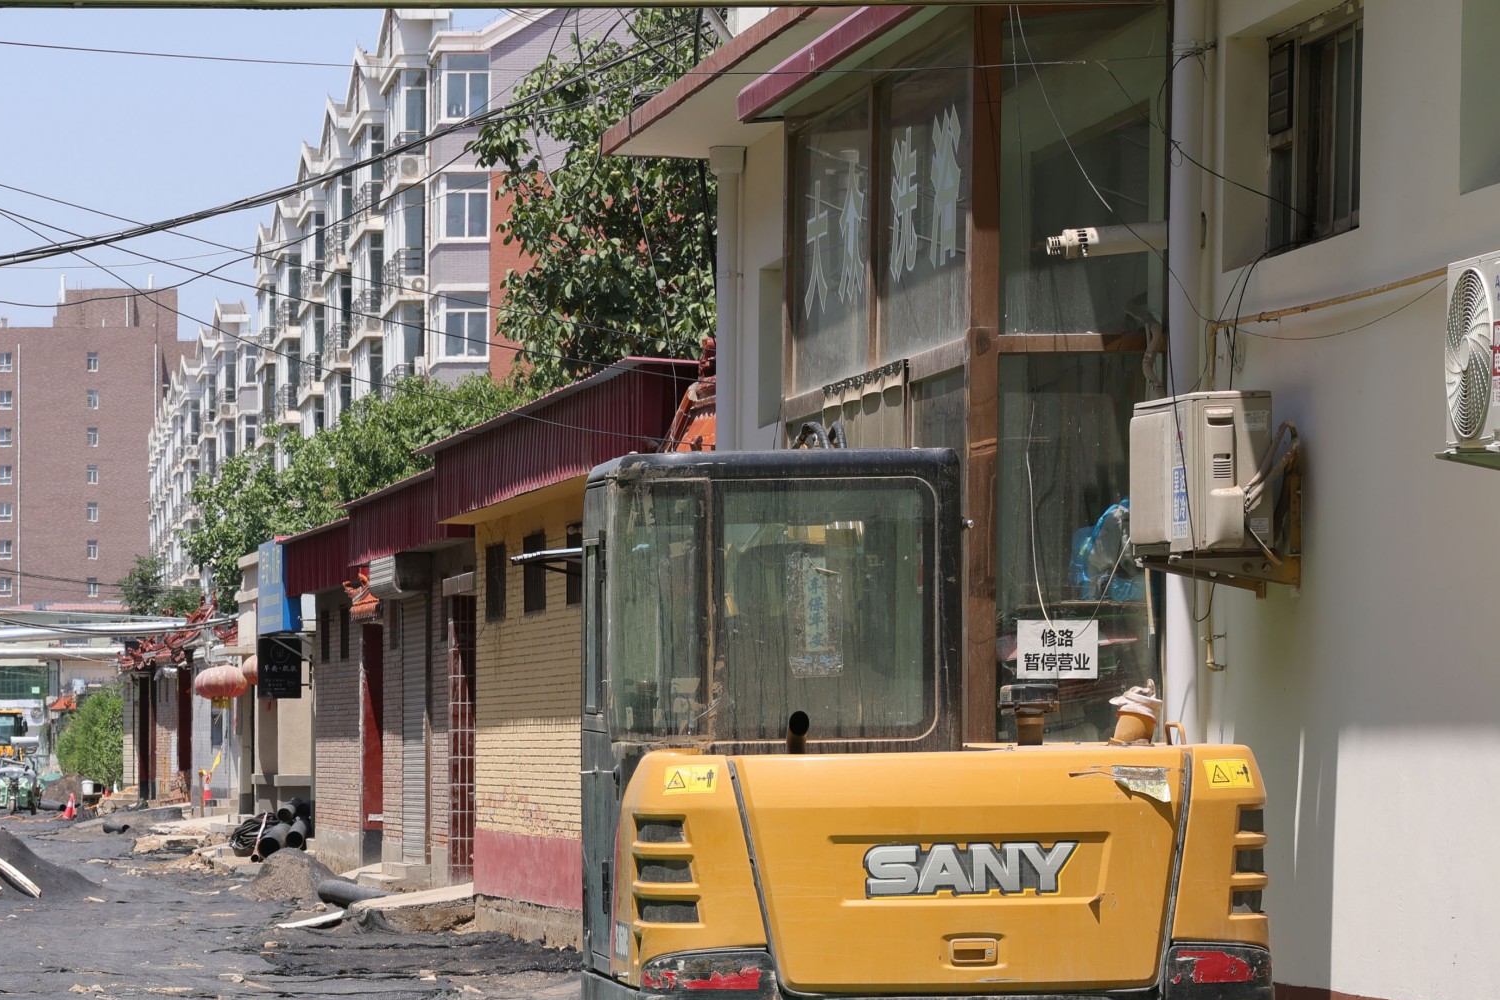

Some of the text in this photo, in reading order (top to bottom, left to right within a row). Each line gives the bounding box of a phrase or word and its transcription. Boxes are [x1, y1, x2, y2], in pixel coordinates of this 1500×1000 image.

[1041, 629, 1073, 647] 修路
[1024, 653, 1090, 671] 暂停营业
[864, 841, 1079, 898] SANY
